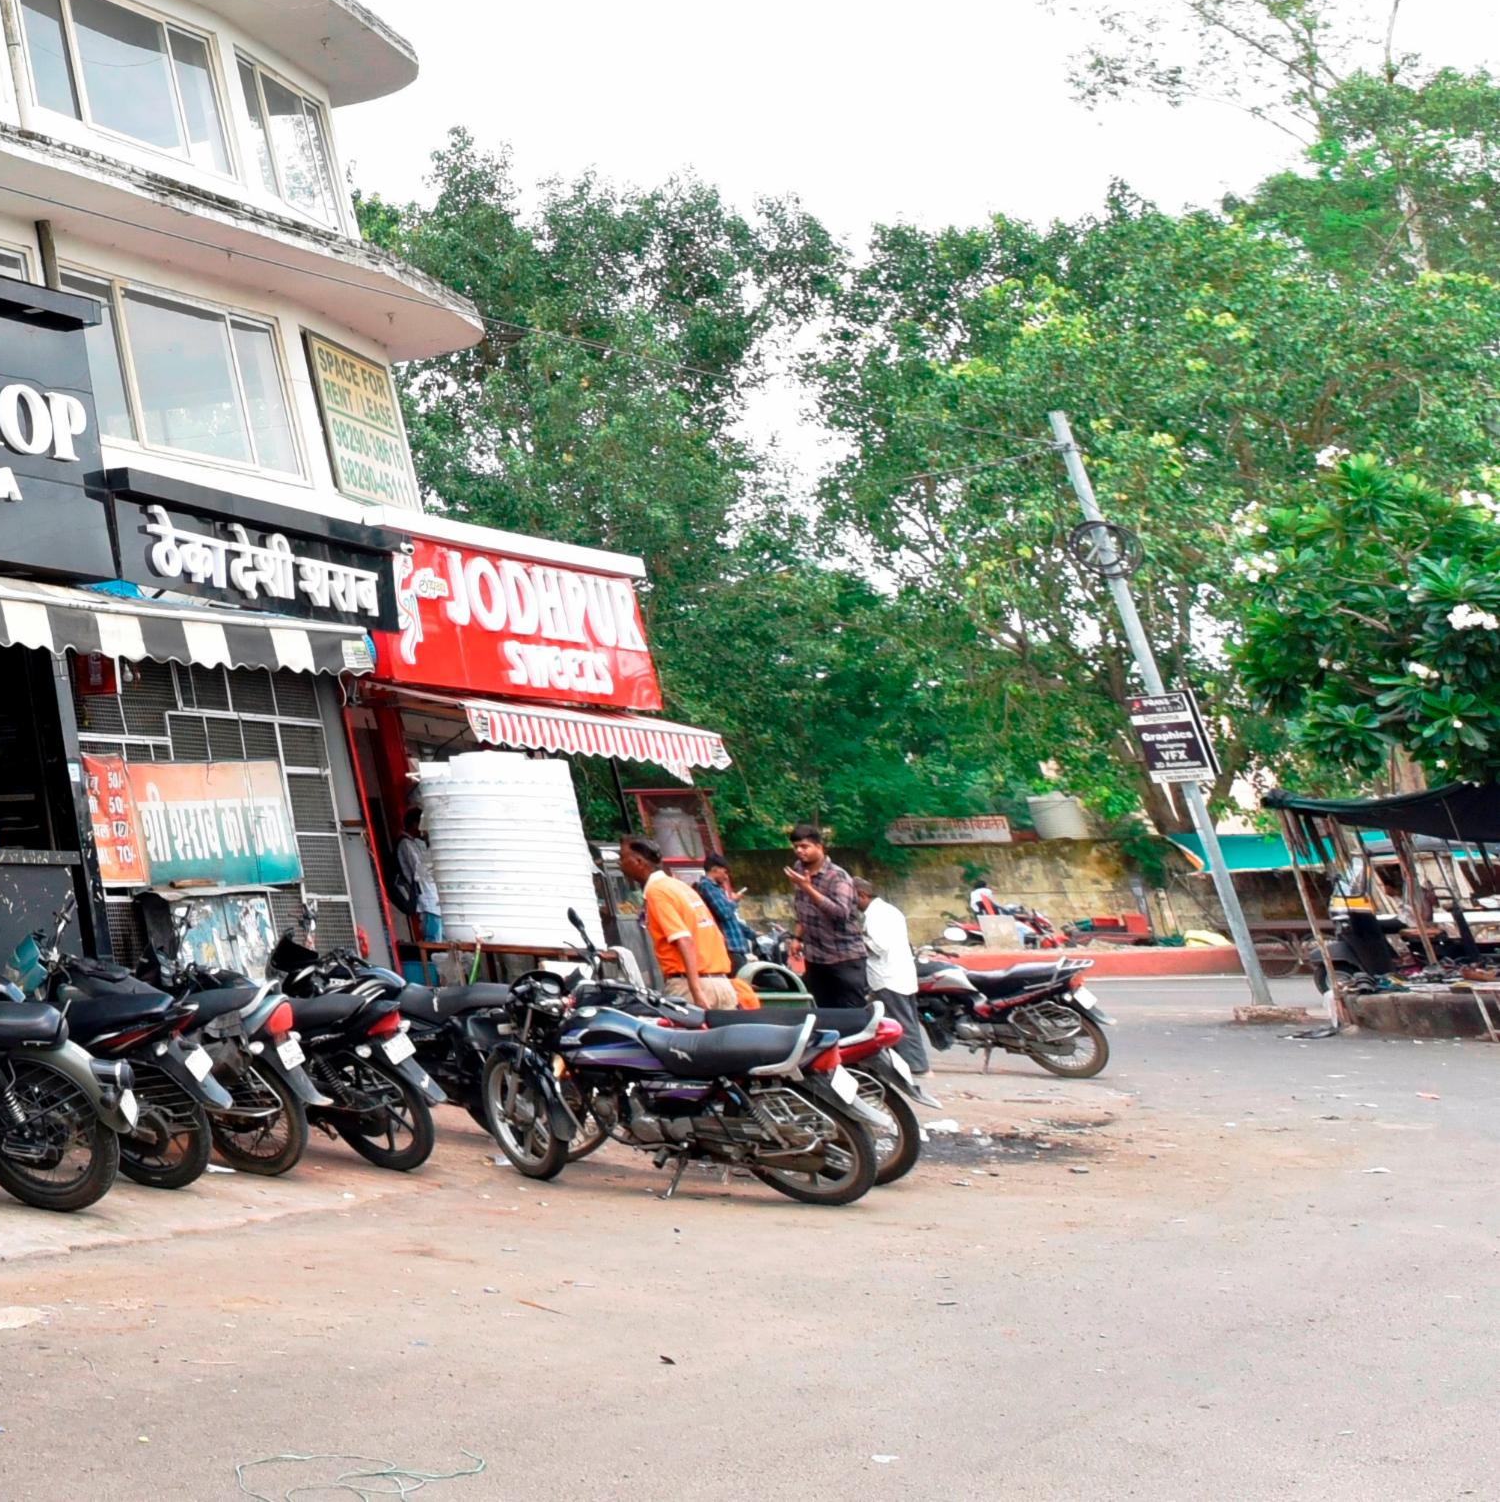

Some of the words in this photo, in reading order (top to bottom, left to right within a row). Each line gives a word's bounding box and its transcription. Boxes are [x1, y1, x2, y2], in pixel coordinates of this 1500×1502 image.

[317, 346, 361, 388] SPACE
[360, 366, 388, 398] FOR
[323, 378, 355, 413] RENT
[359, 393, 395, 430] LEASE
[147, 504, 229, 589] ठेका
[228, 523, 296, 600] देशी
[295, 555, 380, 618] शराब
[445, 550, 649, 652] JODHPUR
[503, 640, 614, 696] SWEETS
[1141, 731, 1194, 742] Graphics
[1159, 750, 1189, 761] VFX
[166, 800, 224, 863] शराब
